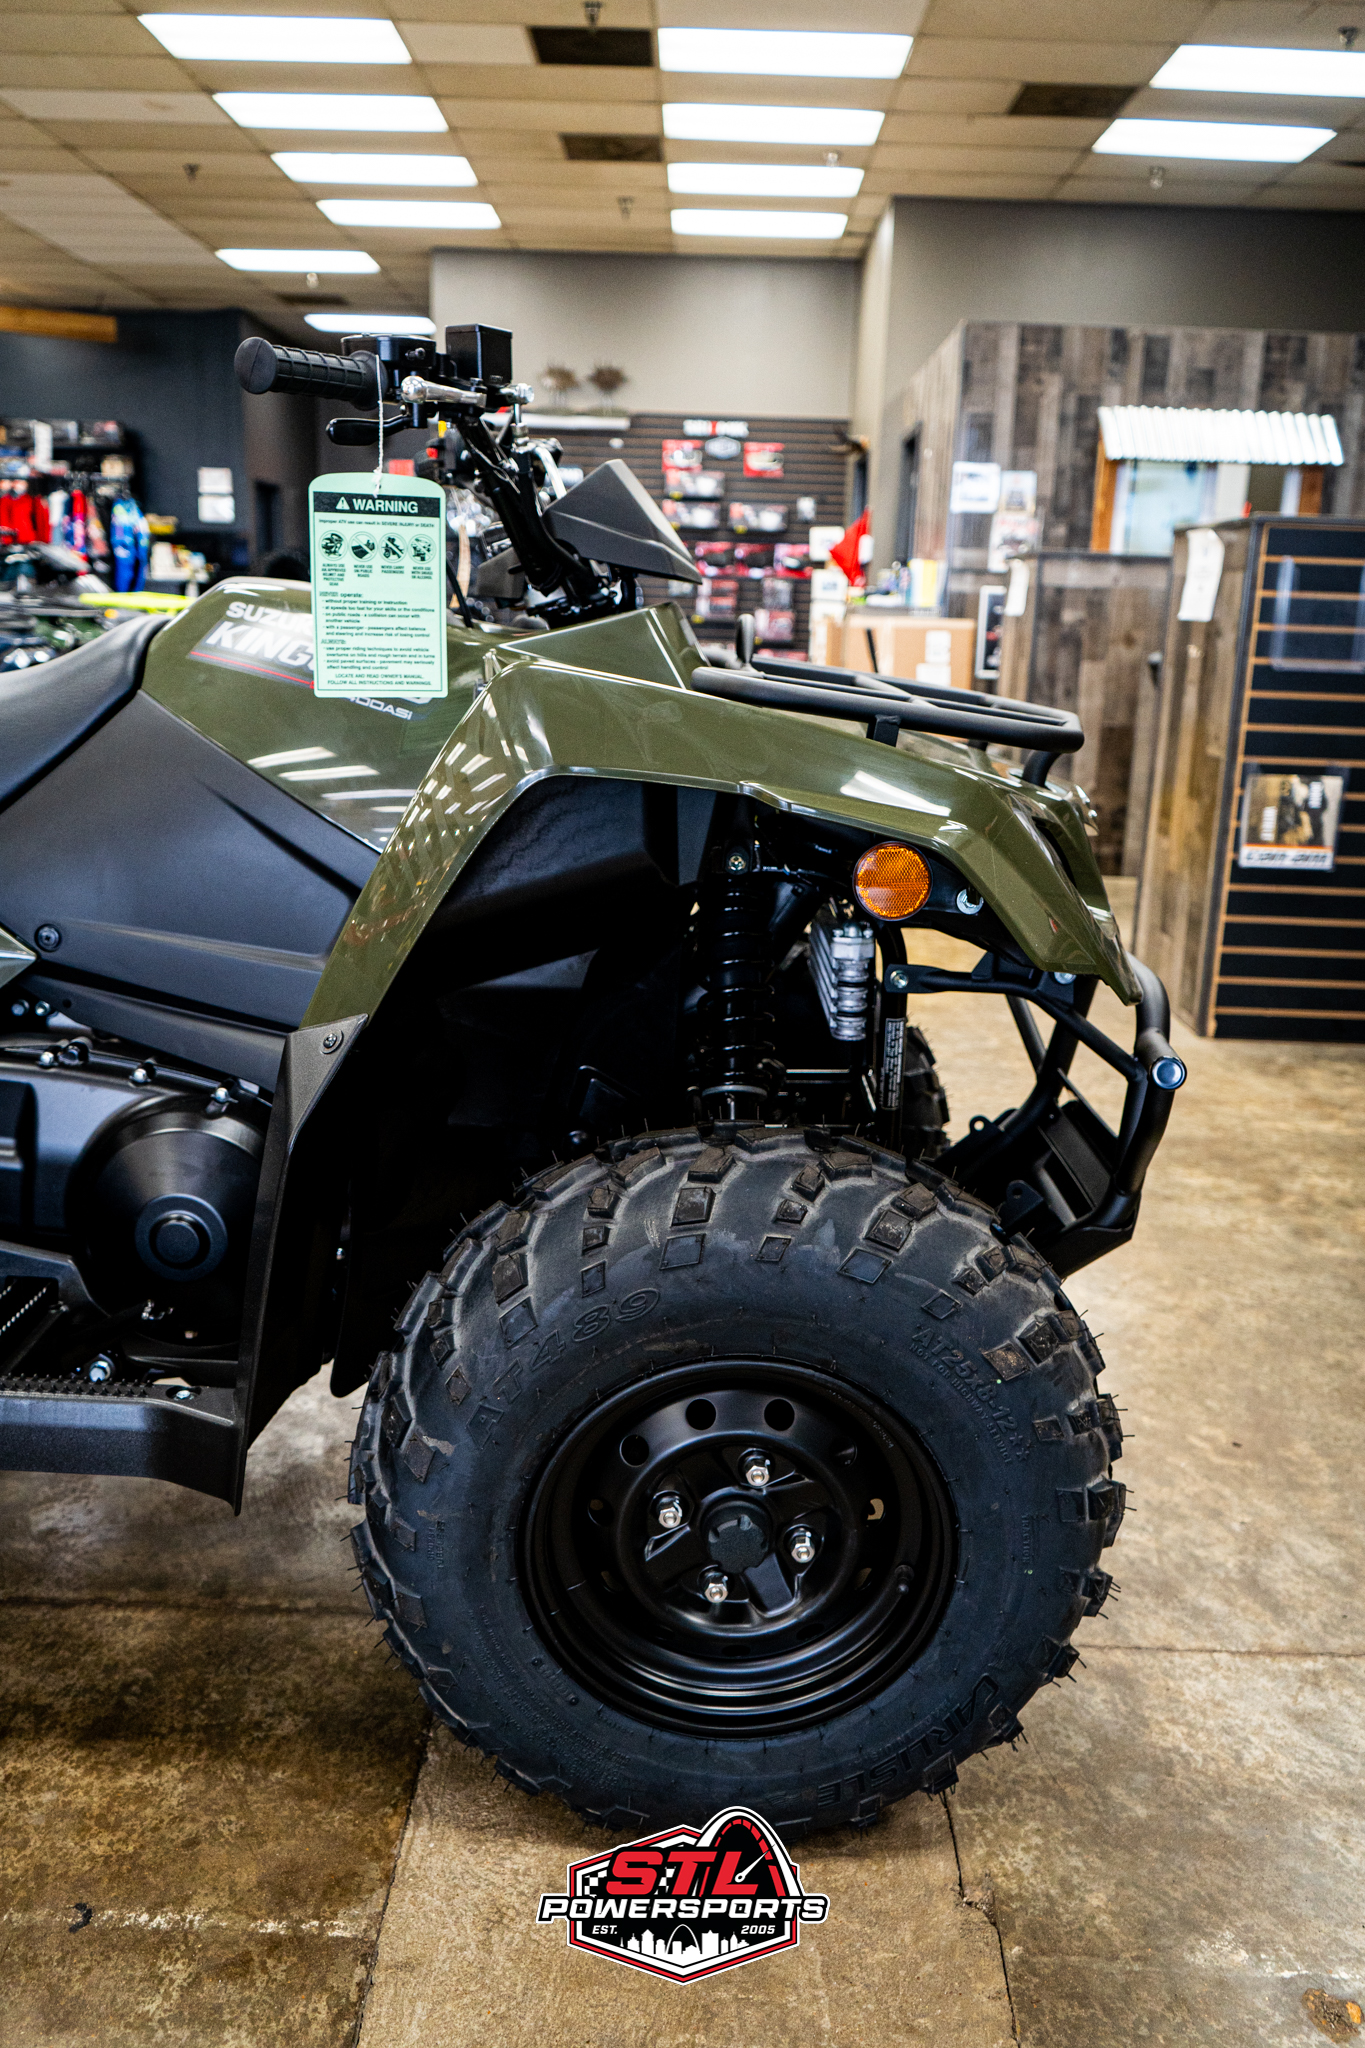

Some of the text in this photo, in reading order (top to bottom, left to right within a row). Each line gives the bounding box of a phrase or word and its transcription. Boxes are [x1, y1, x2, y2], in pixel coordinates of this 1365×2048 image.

[352, 498, 419, 513] WARNING
[226, 601, 314, 636] SUZUK
[205, 620, 314, 671] KING
[908, 1341, 931, 1361] NOT
[931, 1359, 951, 1384] FOR
[951, 1378, 989, 1420] HIGHWAY
[817, 1672, 999, 1809] CARLISLE
